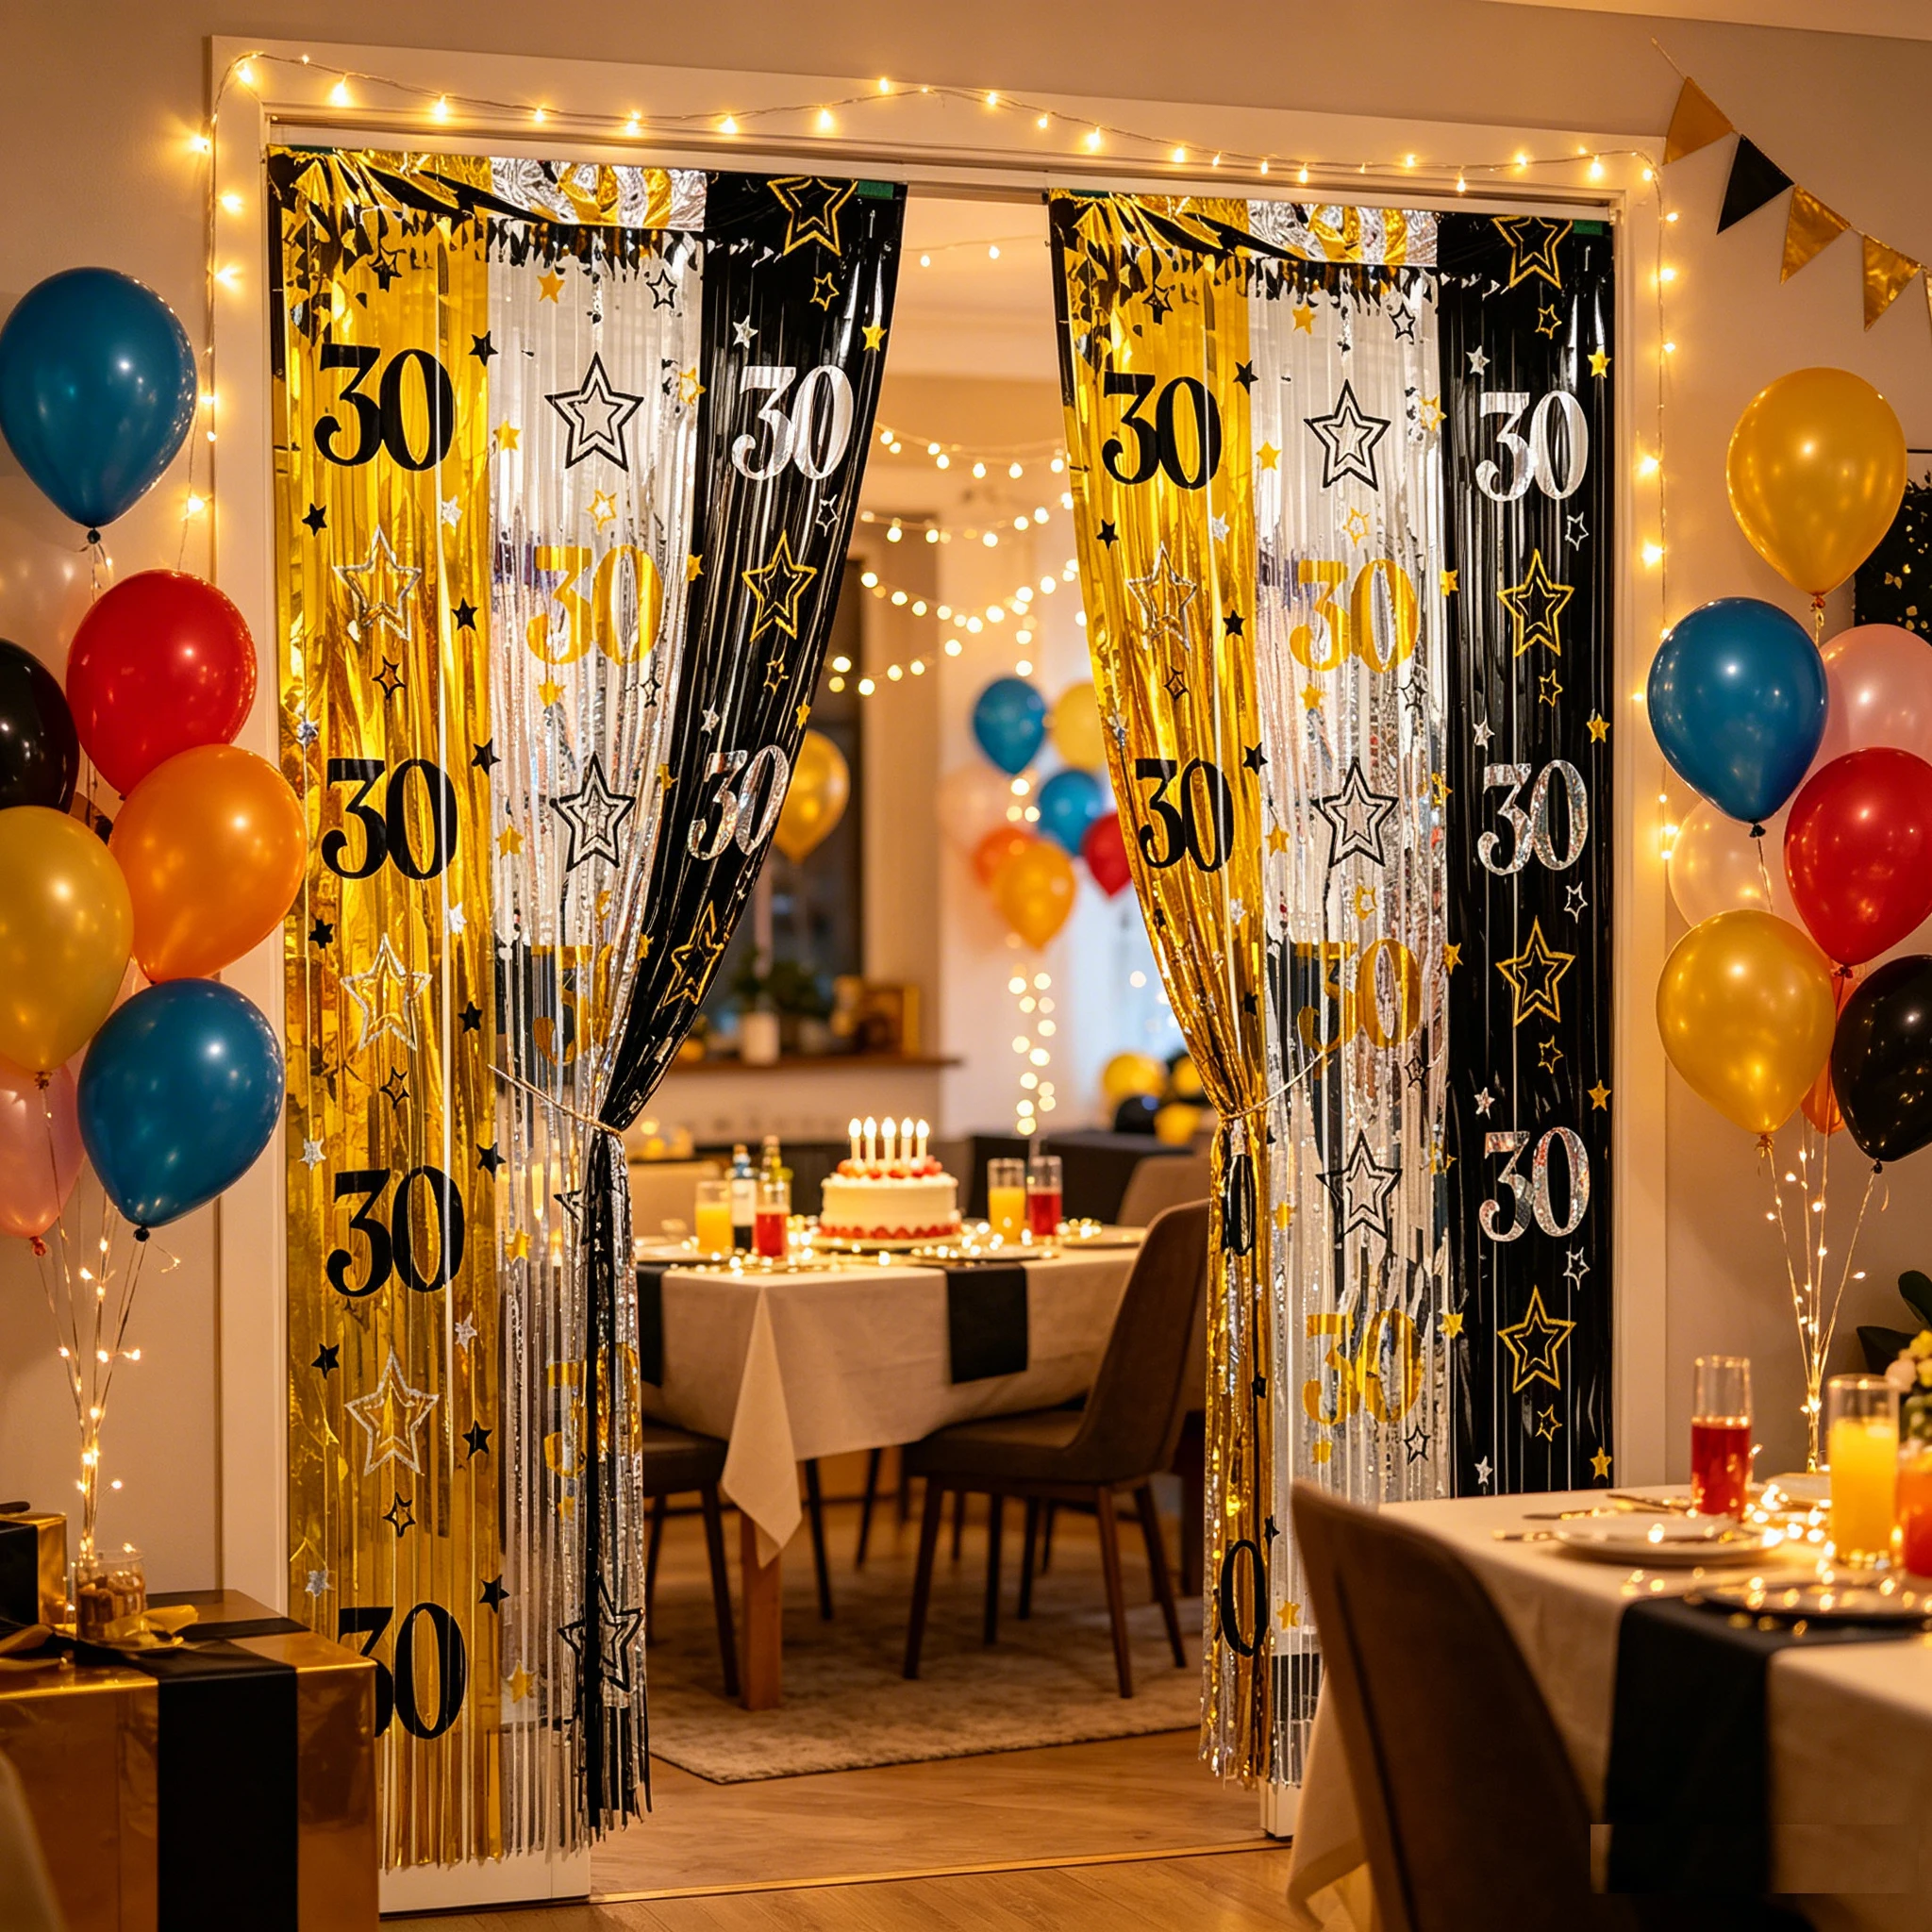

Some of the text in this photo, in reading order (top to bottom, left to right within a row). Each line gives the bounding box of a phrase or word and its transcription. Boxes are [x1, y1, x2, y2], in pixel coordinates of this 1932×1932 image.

[314, 345, 455, 471] 30
[730, 365, 854, 481] 30
[1102, 373, 1223, 489] 30
[1474, 389, 1590, 503] 30
[525, 544, 662, 665] 30
[1290, 559, 1417, 673] 30
[320, 758, 458, 880] 30
[686, 744, 791, 860] 30
[1135, 758, 1234, 873] 30
[1475, 758, 1590, 876] 30
[1296, 938, 1422, 1051] 30
[325, 1165, 464, 1297] 30
[1477, 1126, 1591, 1243] 30
[1302, 1308, 1424, 1426] 30
